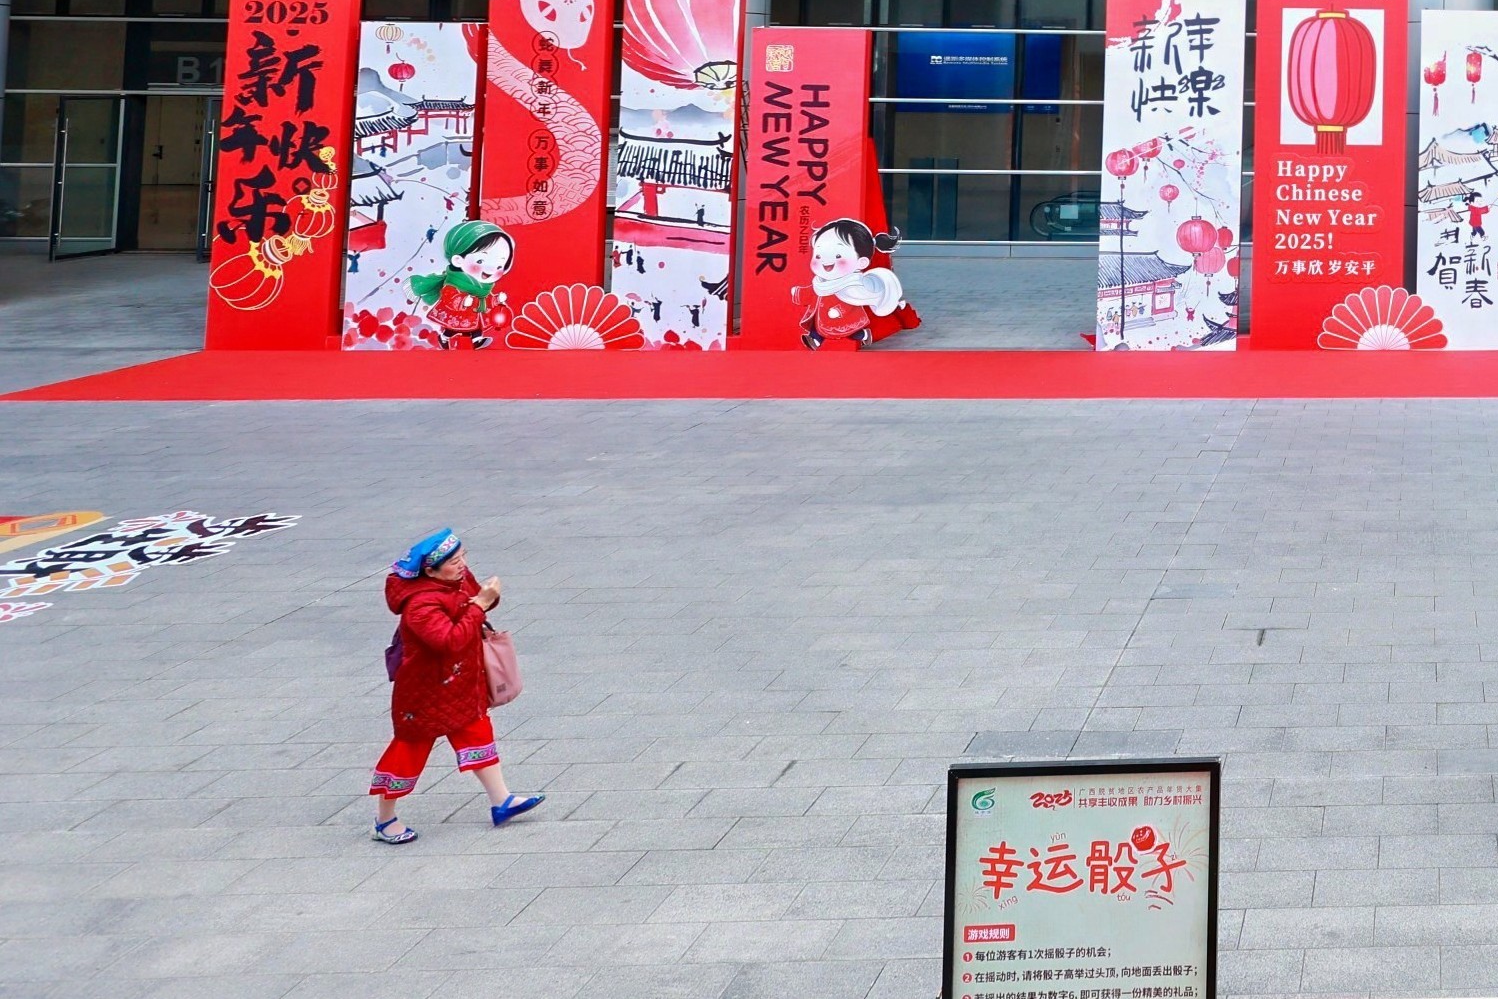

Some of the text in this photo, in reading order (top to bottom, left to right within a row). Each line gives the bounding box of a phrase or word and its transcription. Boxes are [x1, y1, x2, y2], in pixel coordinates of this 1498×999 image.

[244, 0, 329, 25] 2025
[761, 80, 794, 168] NEW
[797, 84, 830, 206] HAPPY
[1276, 160, 1348, 185] Happy
[1276, 184, 1363, 202] Chinese
[755, 174, 790, 276] YEAR
[1275, 209, 1377, 226] New Year
[1274, 233, 1334, 250] 2025!
[1029, 789, 1073, 810] 2025
[1078, 794, 1202, 808] 共享丰收成果 助力乡村振兴
[979, 840, 1187, 899] 幸运骰子
[967, 928, 1010, 940] 游戏规则
